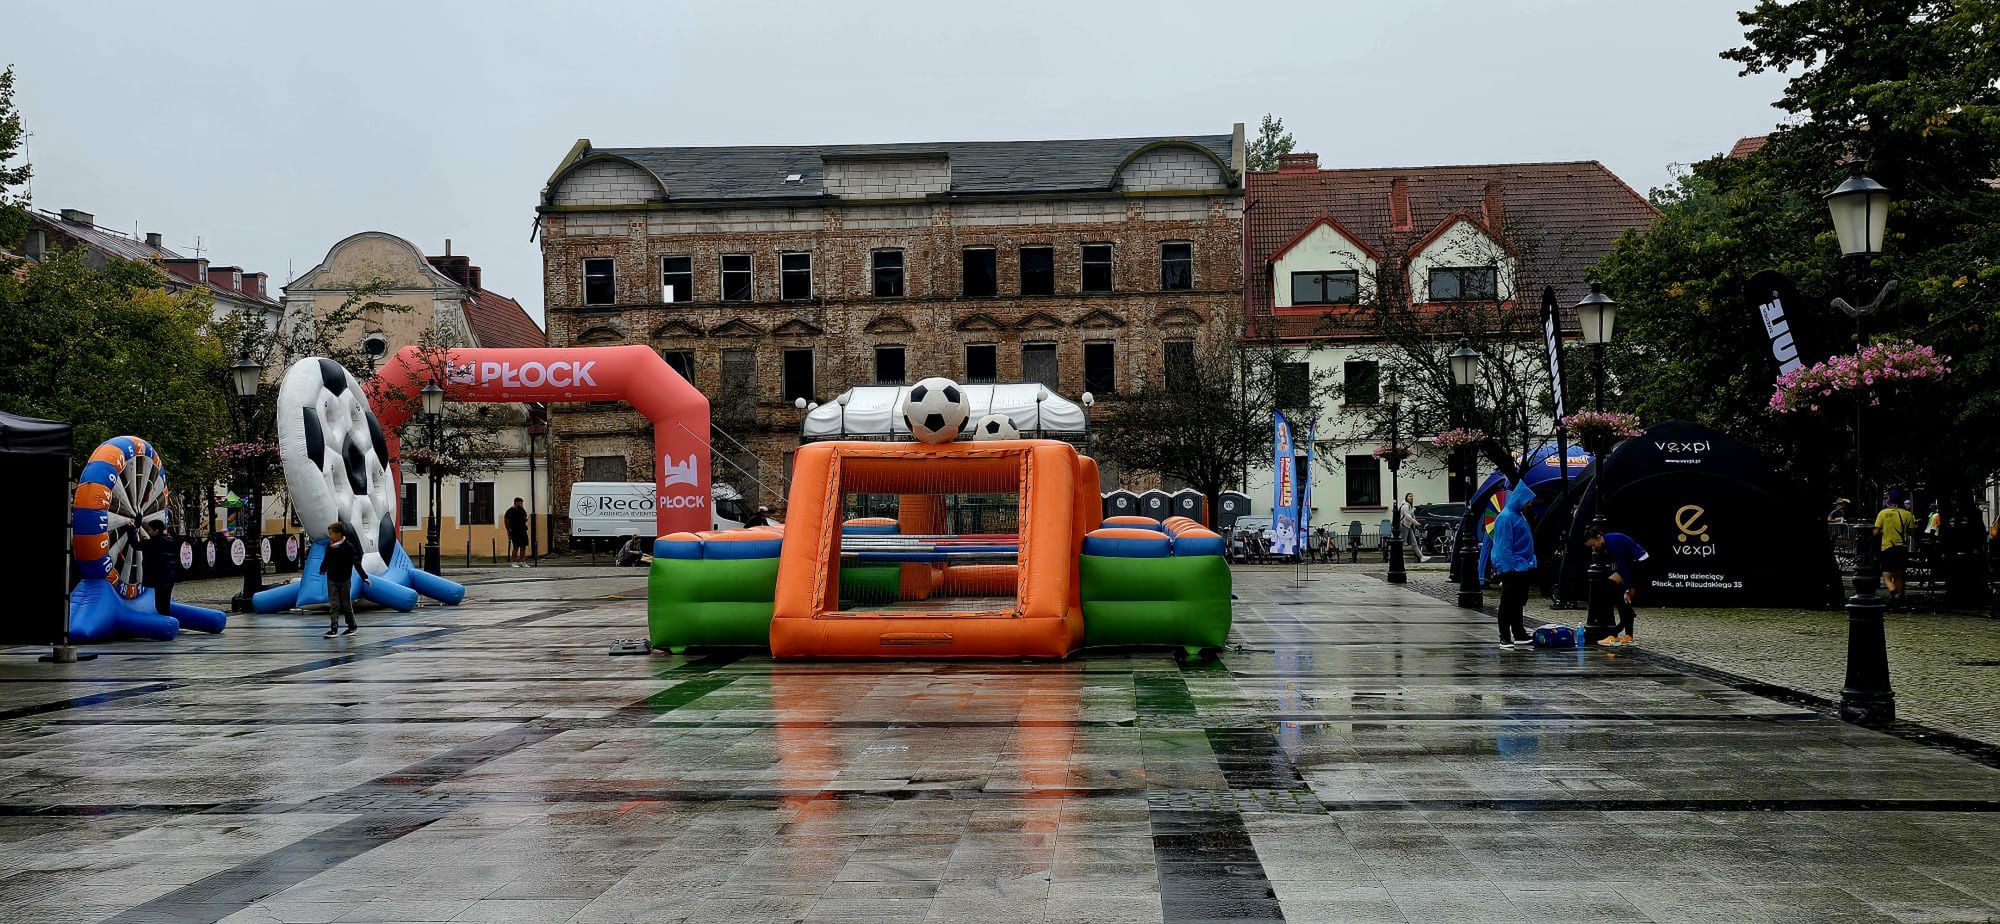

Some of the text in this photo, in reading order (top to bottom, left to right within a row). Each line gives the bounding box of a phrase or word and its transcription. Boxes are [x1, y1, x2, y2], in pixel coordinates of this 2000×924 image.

[481, 361, 597, 388] PŁOCK
[1654, 440, 1711, 454] vexpl
[108, 473, 117, 484] 9
[599, 496, 654, 510] Reco
[660, 495, 705, 509] PŁOCK
[99, 515, 108, 529] 11
[100, 540, 109, 549] 8
[1672, 543, 1716, 558] vexpl
[102, 556, 113, 573] 16
